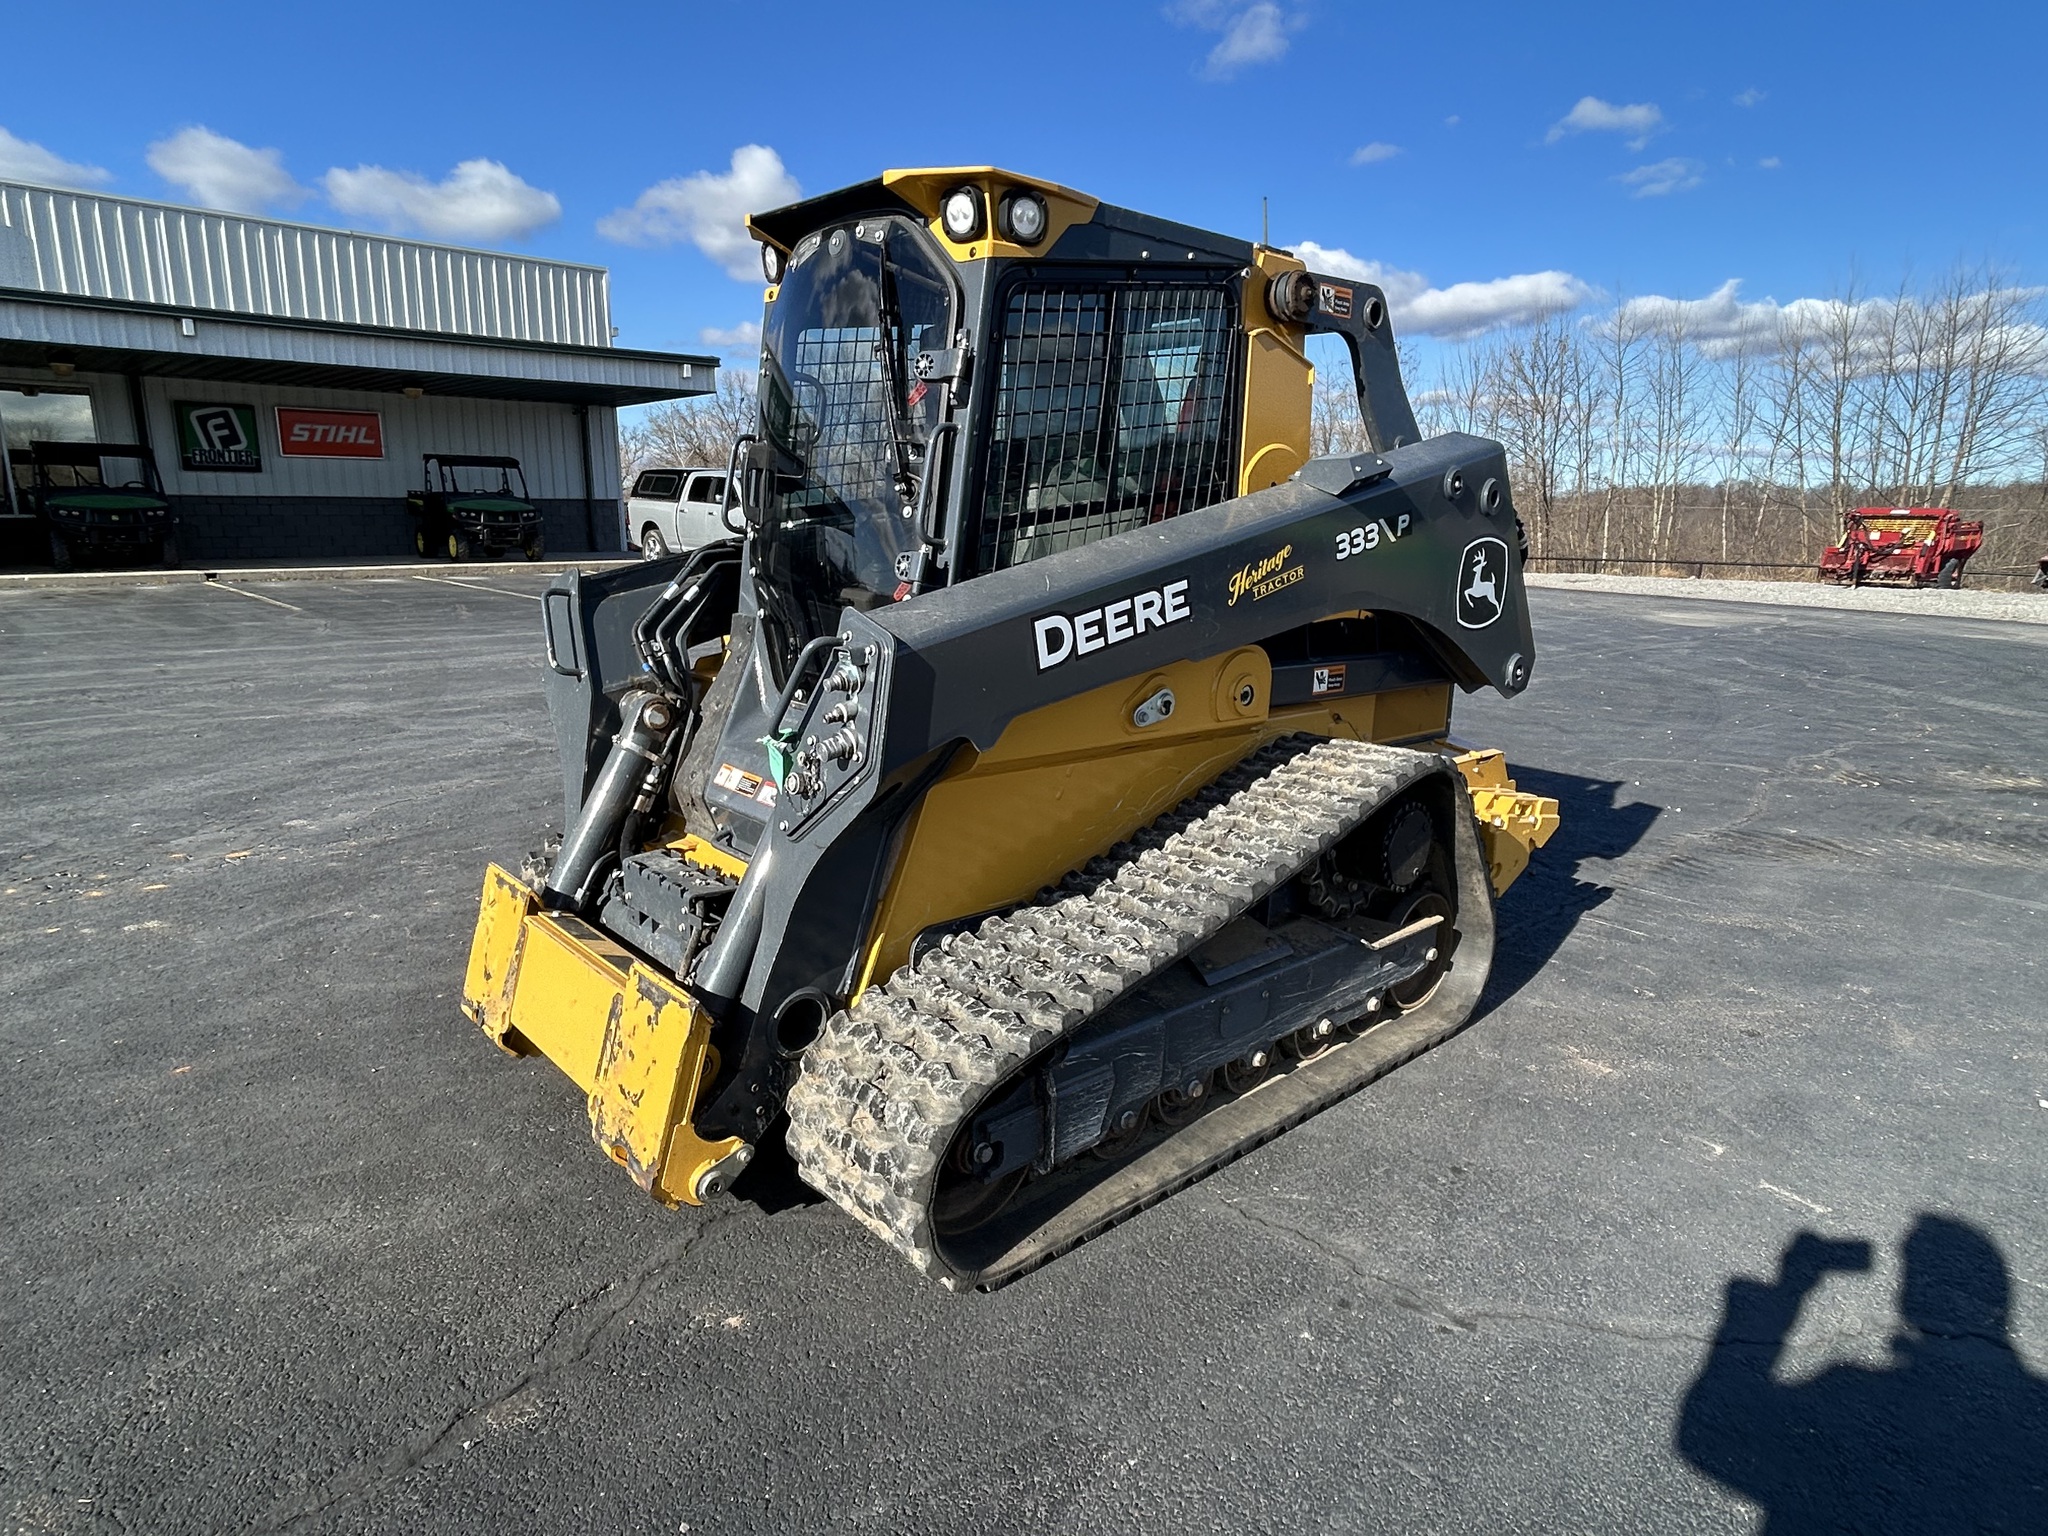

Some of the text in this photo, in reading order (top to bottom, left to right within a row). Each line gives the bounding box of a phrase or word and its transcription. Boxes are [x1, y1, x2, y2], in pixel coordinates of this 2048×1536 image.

[289, 423, 375, 445] STIHL
[191, 449, 256, 466] FRONTIER
[1228, 544, 1293, 607] Heritage
[1252, 566, 1305, 600] TRACTOR
[1034, 579, 1190, 670] DEERE
